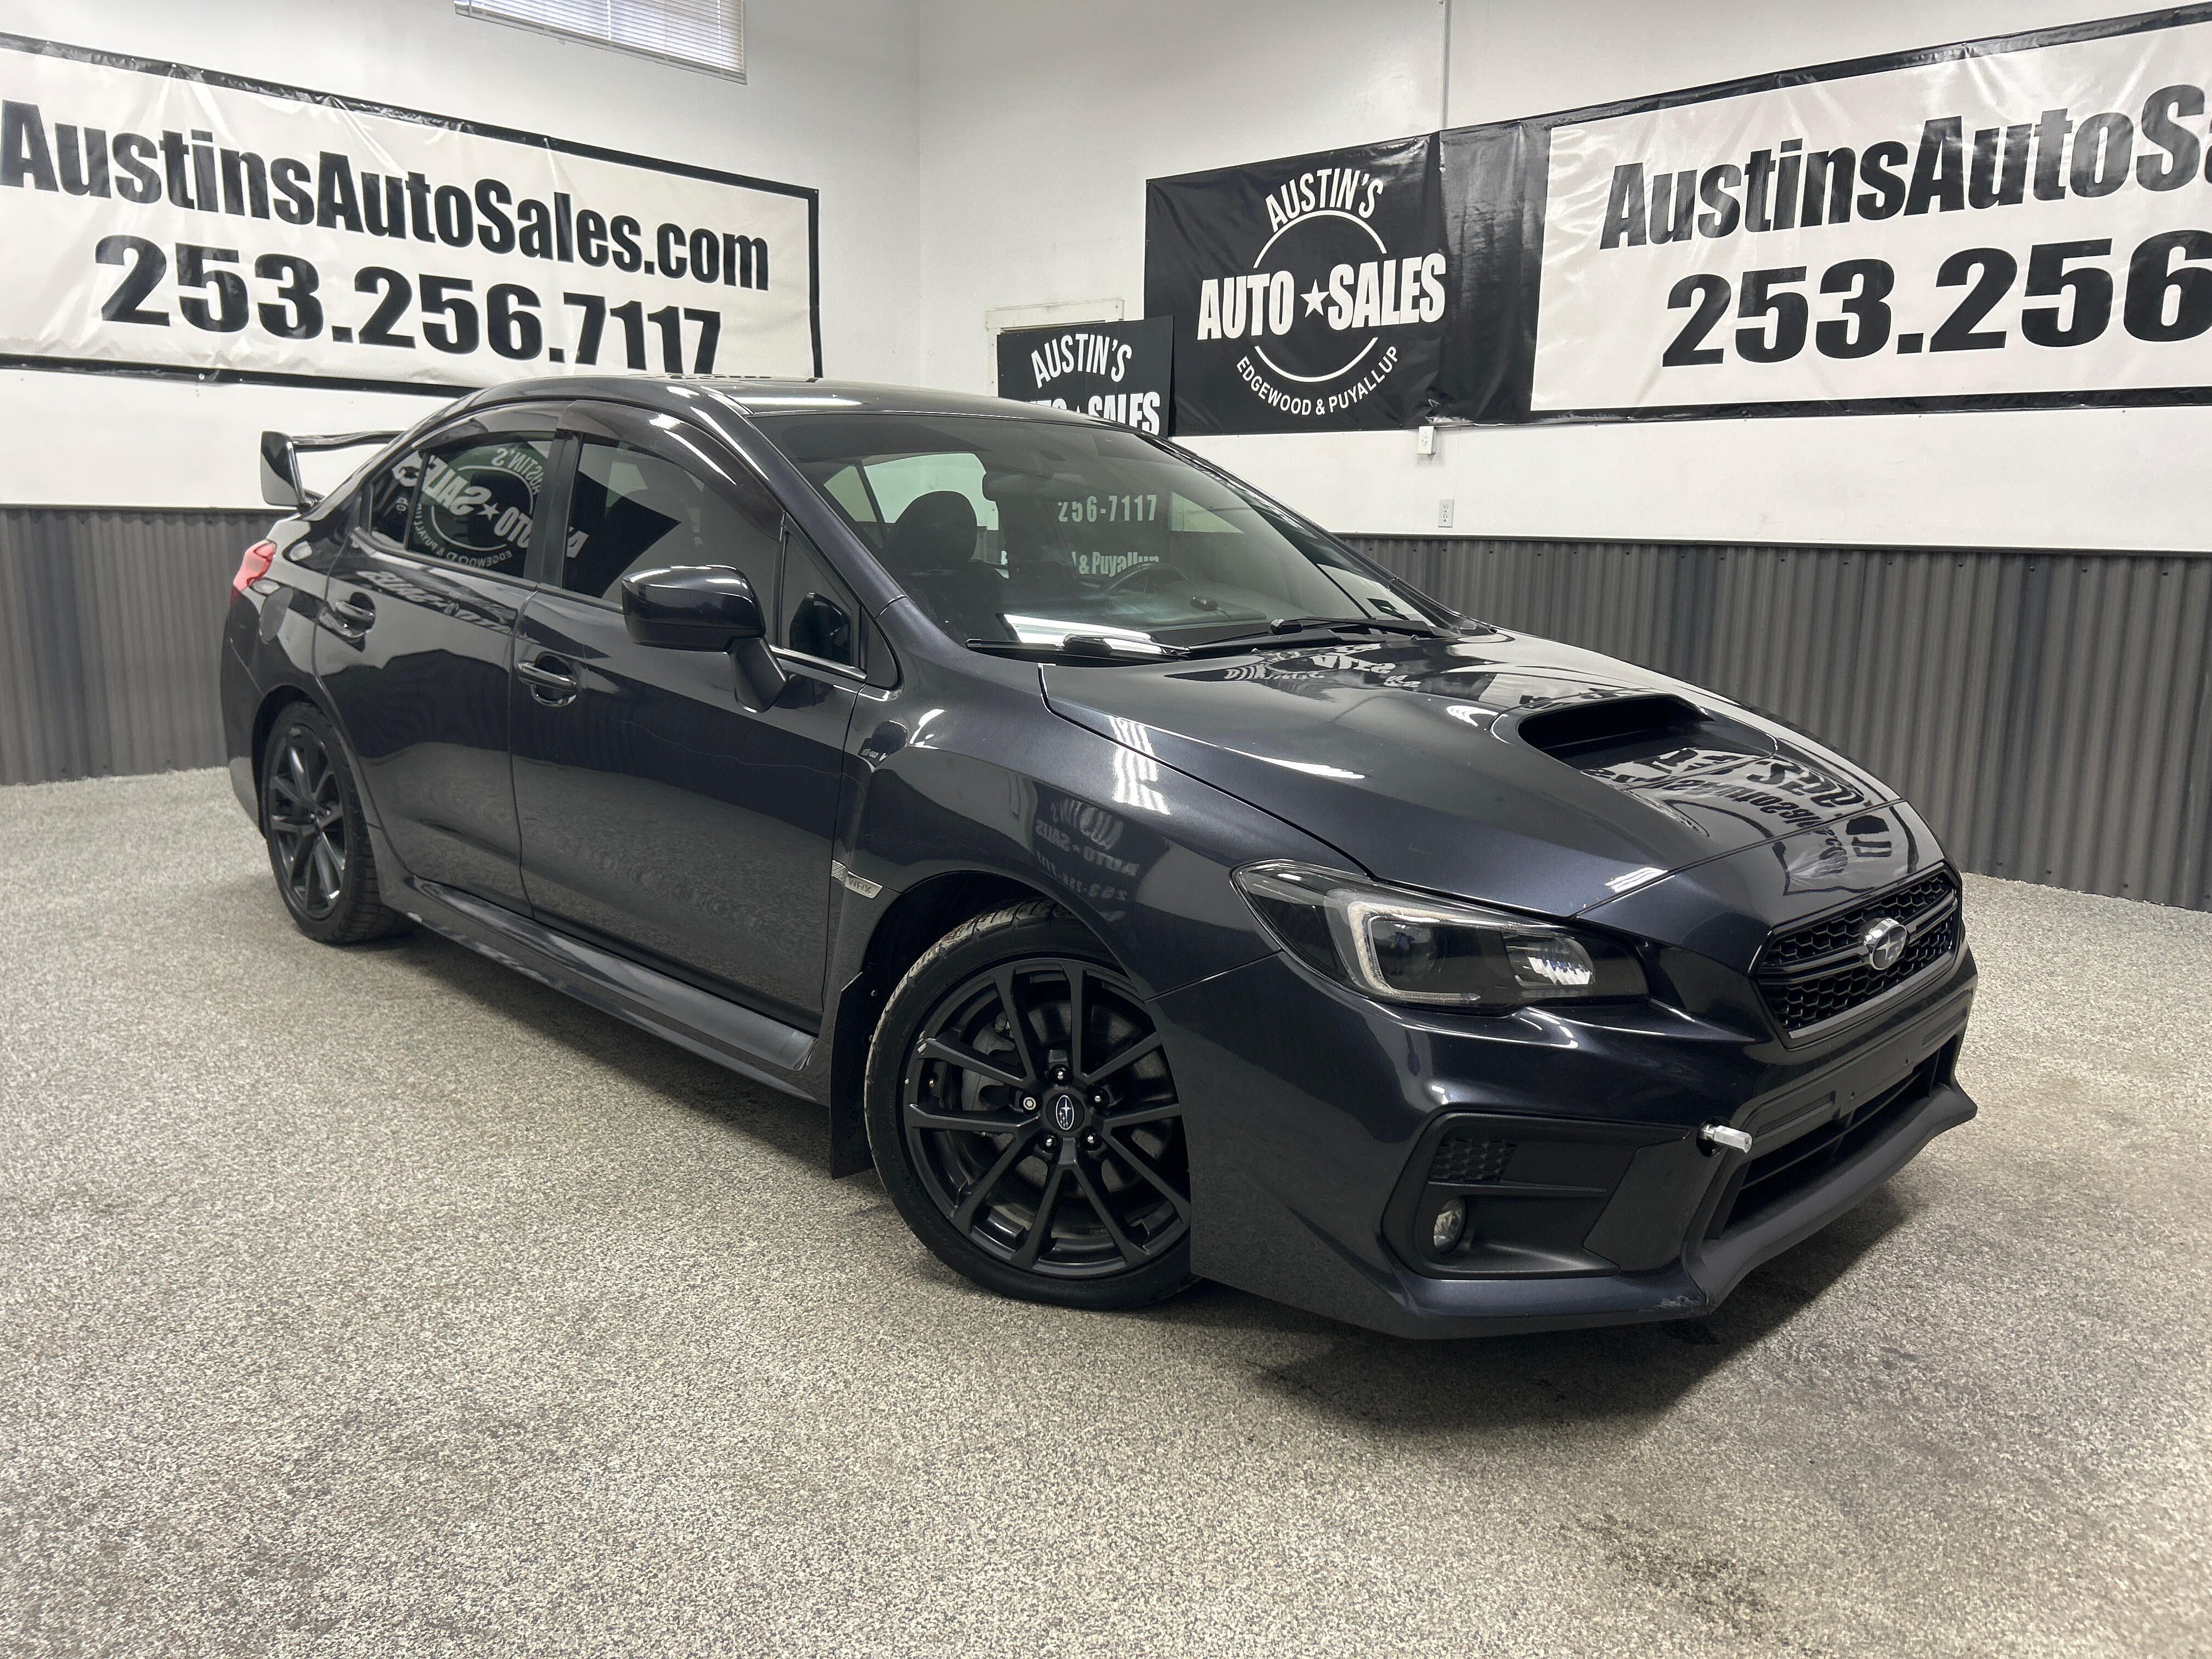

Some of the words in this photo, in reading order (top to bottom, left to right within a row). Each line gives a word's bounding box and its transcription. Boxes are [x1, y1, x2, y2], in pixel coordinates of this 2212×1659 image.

[0, 99, 769, 291] AustinsAutoSales.com
[1265, 168, 1383, 233] AUSTIN'S
[1600, 84, 2212, 250] AustinsAutoS
[95, 234, 721, 375] 253.256.7117
[1197, 270, 1294, 340] AUTO
[1327, 253, 1446, 330] SALES
[1662, 229, 2212, 368] 253.256
[1031, 334, 1132, 388] AUSTIN'S
[1237, 356, 1311, 416] EDGEWOOD
[1315, 398, 1325, 416] &
[1328, 346, 1398, 413] PUYALLUP
[1057, 495, 1157, 522] 256-7117
[1092, 551, 1159, 577] Puyall
[849, 878, 871, 893] WRX
